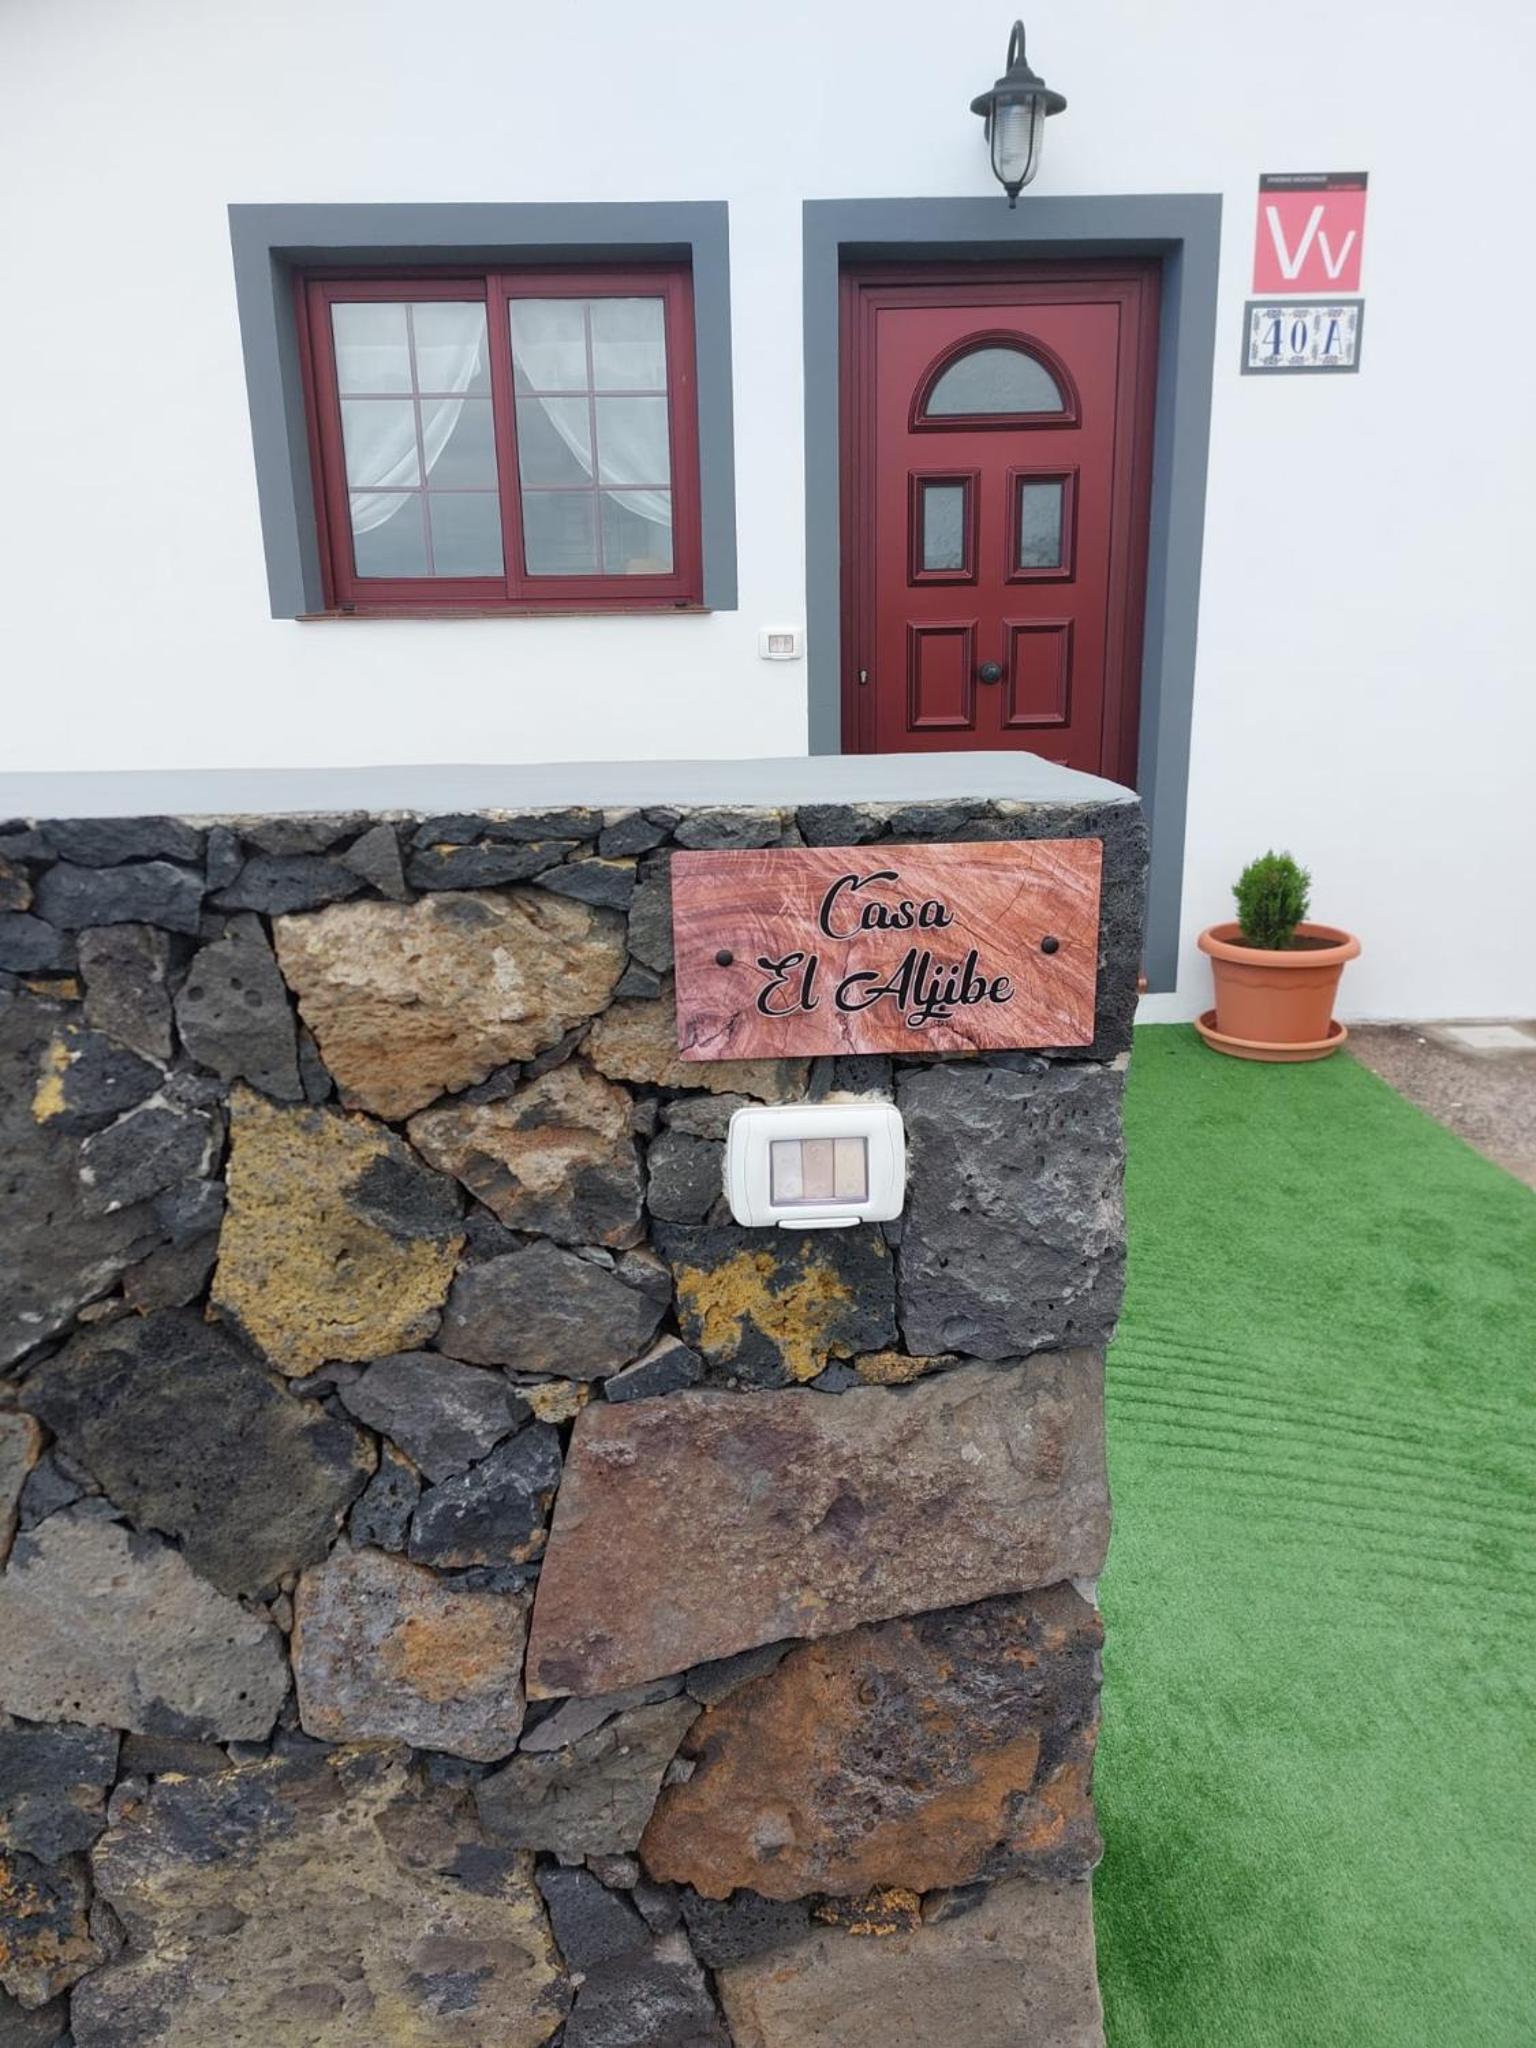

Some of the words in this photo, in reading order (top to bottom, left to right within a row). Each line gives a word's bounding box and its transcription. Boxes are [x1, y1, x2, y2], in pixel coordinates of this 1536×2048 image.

[819, 871, 954, 939] Casa
[757, 952, 820, 1017] El
[835, 948, 1015, 1027] Aljibe
